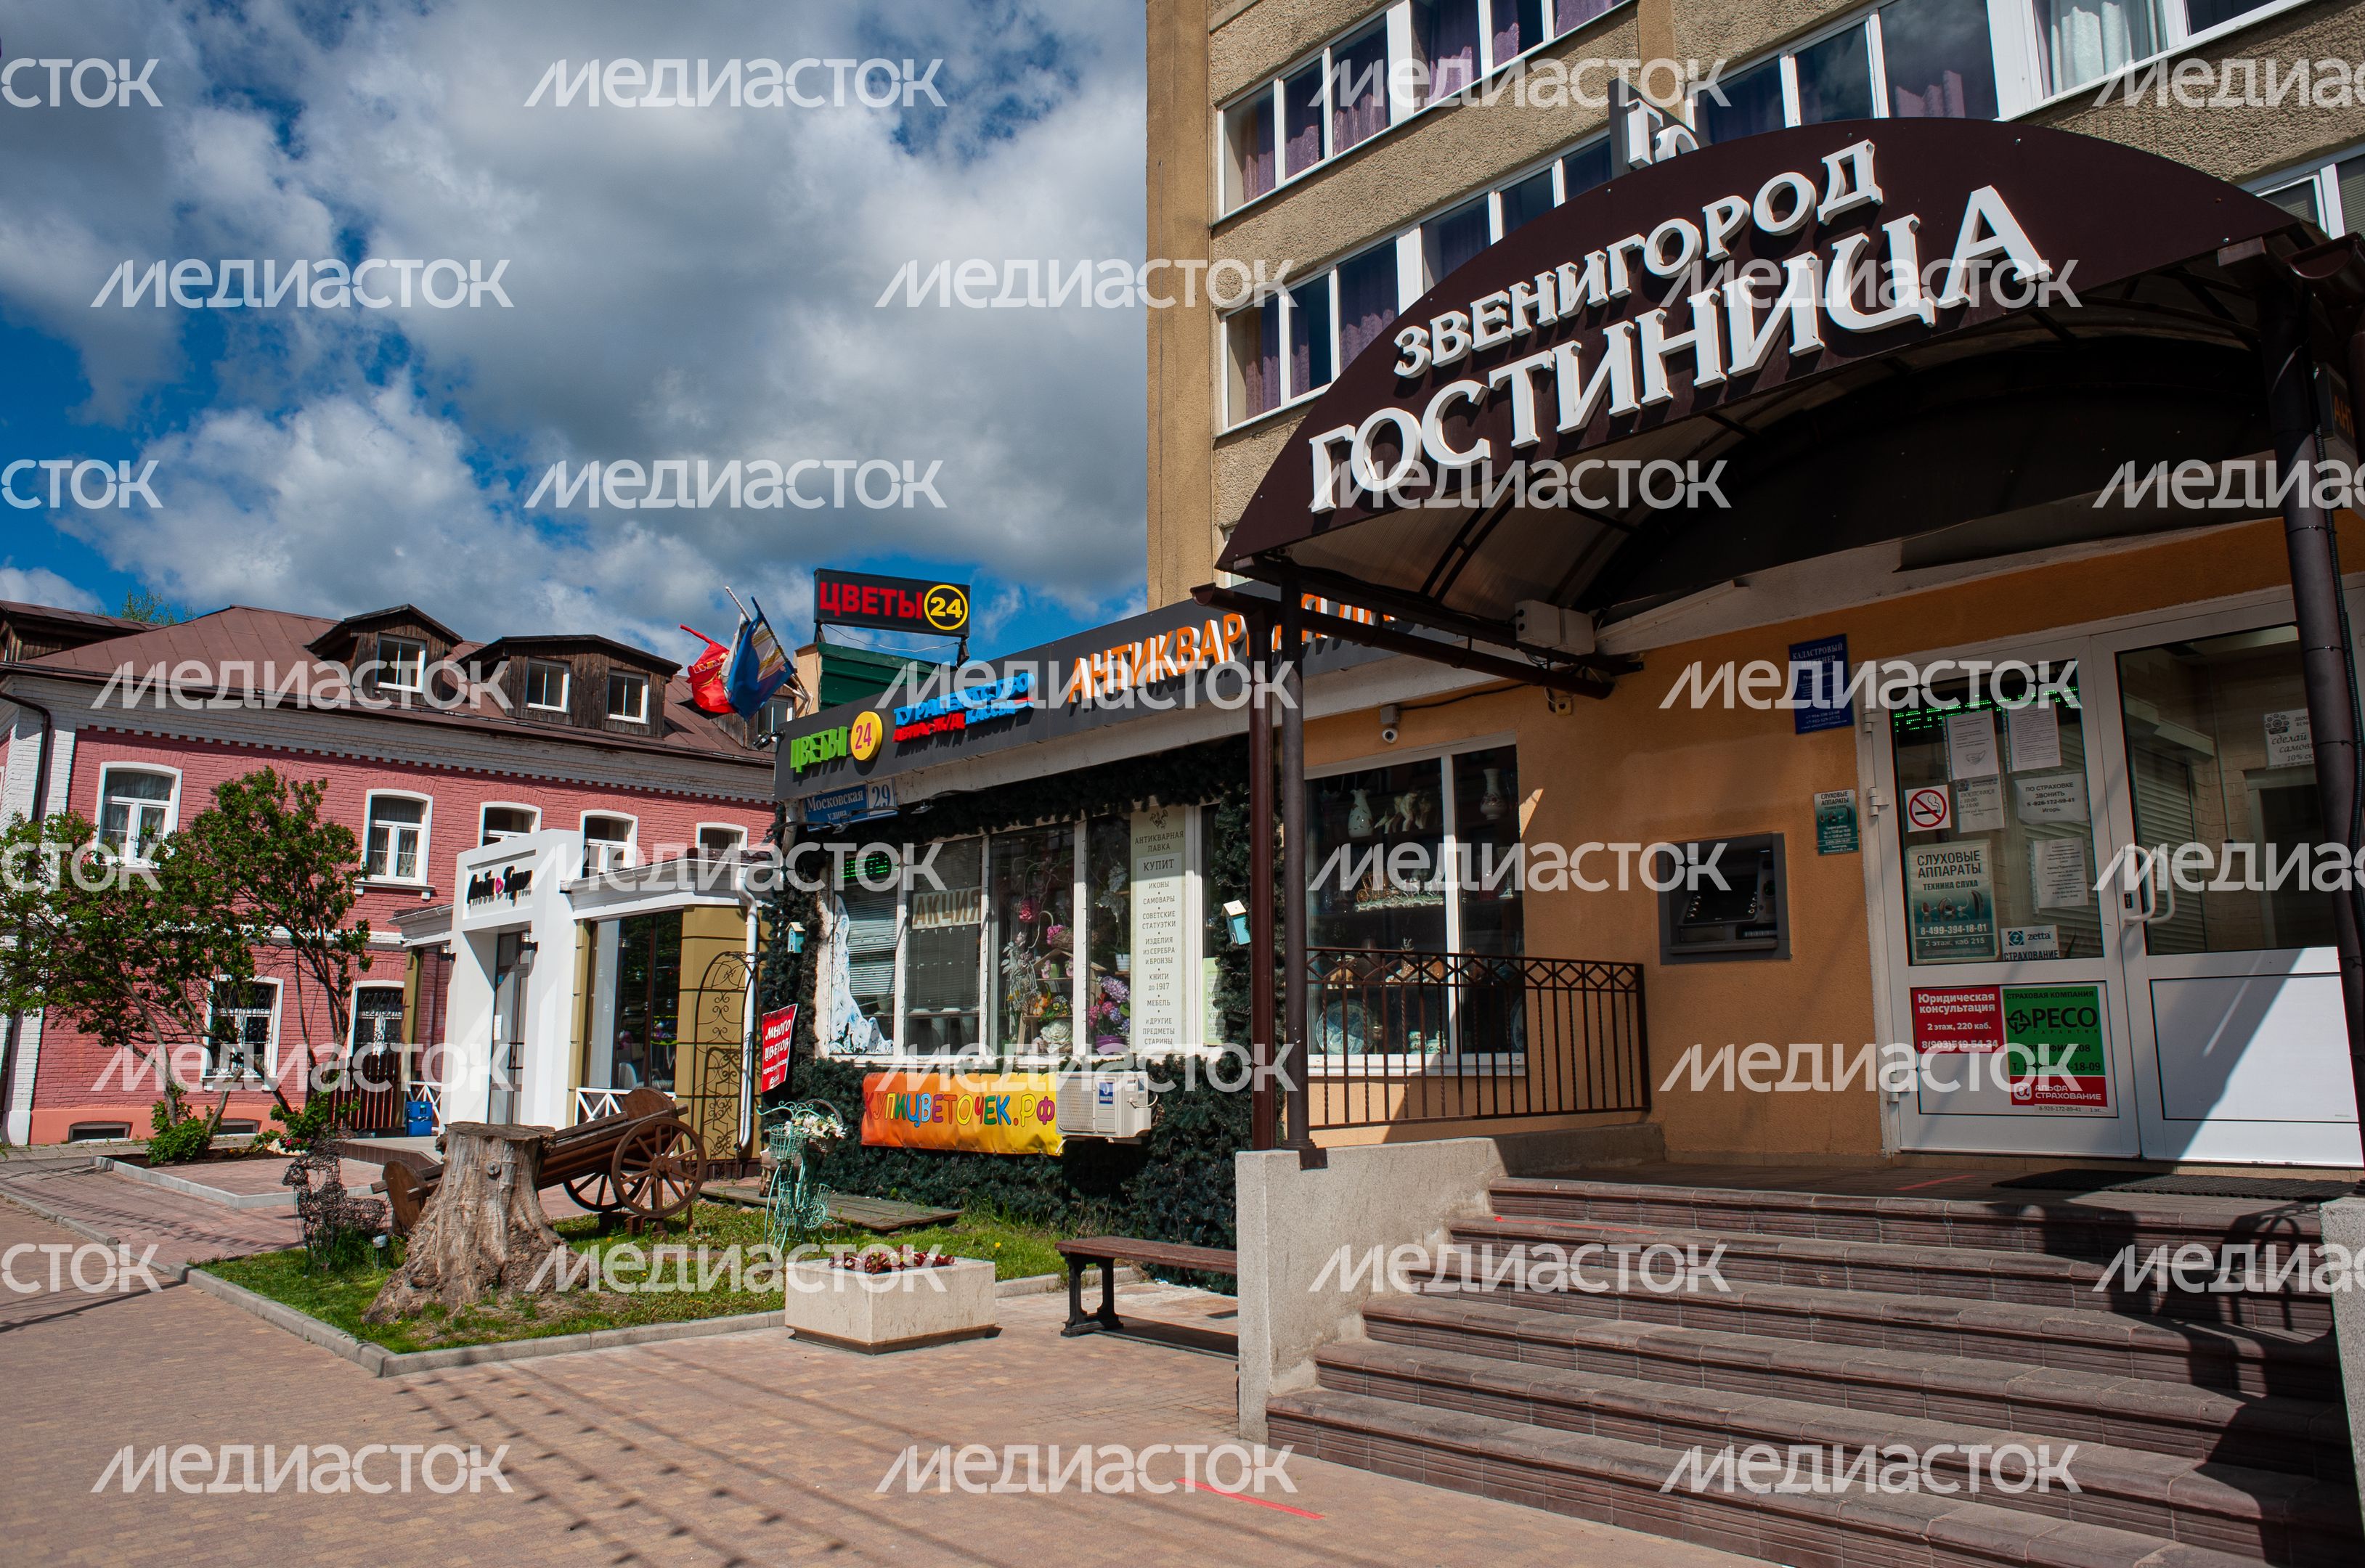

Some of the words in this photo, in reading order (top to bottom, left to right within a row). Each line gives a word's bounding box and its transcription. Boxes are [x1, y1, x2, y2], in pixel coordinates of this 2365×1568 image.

[1393, 139, 1884, 380] ЗВЕНИГОРОД
[1309, 184, 2053, 515] ГОСТИНИЦА
[819, 581, 923, 619] ЦВЕТЫ
[930, 597, 963, 618] 24
[1792, 642, 1843, 661] КАДАСТРОВЫЙ
[2271, 732, 2307, 745] сделай
[790, 726, 848, 773] ЦВЕТЫ
[855, 722, 873, 751] 24
[2036, 782, 2074, 791] СТРАХОВКЕ
[807, 789, 864, 812] Московская
[871, 784, 891, 808] 29
[1820, 791, 1849, 799] СЛУХОВЫЕ
[1135, 830, 1184, 845] АНТИКВАРНАЯ
[1147, 843, 1171, 853] ЛАВКА
[1917, 850, 1981, 867] СЛУХОВЫЕ
[1144, 859, 1174, 872] КУПИТ
[1918, 863, 1982, 878] АППАРАТЫ
[1149, 881, 1169, 889] ИКОНЫ
[1923, 881, 1955, 891] ТЕХНИКА
[1955, 879, 1979, 889] СЛУХА
[1143, 895, 1175, 905] САМОВАРЫ
[913, 889, 981, 926] АКЦИЯ
[1142, 910, 1176, 920] СОВЕТСКИЕ
[1142, 920, 1176, 929] СТАТУЭТКИ
[1920, 923, 1987, 936] 8-499-394-18-01
[1145, 936, 1173, 945] ИЗДЕЛИЯ
[2027, 932, 2051, 941] zetta
[2003, 950, 2059, 962] СТРАХОВАНИЕ
[1918, 993, 1995, 1005] Юридическая
[2050, 990, 2094, 999] КОМПАНИЯ
[1919, 1004, 1995, 1016] консультация
[2032, 1006, 2098, 1029] РЕСО
[765, 1018, 791, 1041] МНОГО
[765, 1037, 789, 1061] ЦВЕТОВ
[2043, 1044, 2069, 1053] ОФИС
[2072, 1043, 2091, 1052] 208
[2035, 1092, 2101, 1101] СТРАХОВАНИЕ
[864, 1091, 1056, 1128] КУПИЦВЕТОЧЕК.РФ
